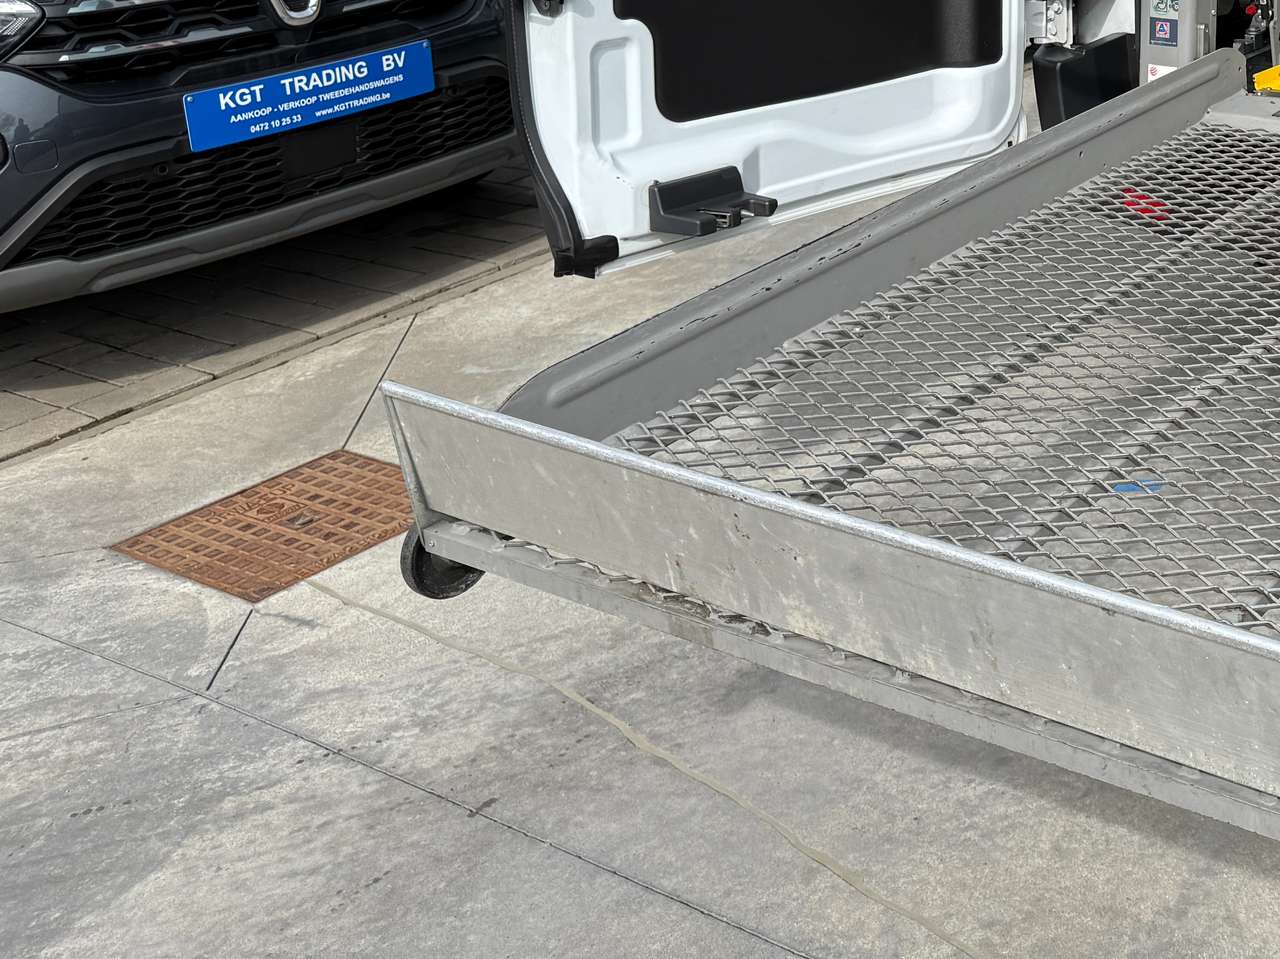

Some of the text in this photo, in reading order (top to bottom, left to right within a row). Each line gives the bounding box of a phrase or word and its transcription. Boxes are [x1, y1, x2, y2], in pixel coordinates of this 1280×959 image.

[218, 50, 406, 110] KGT TRADING BV
[229, 106, 272, 124] AANKOOP
[278, 96, 317, 112] VERKOOP
[318, 73, 404, 102] TWEEDEHANDSWAGENS
[250, 92, 391, 133] 0472 10 25 33 www.KGTTRADING.be
